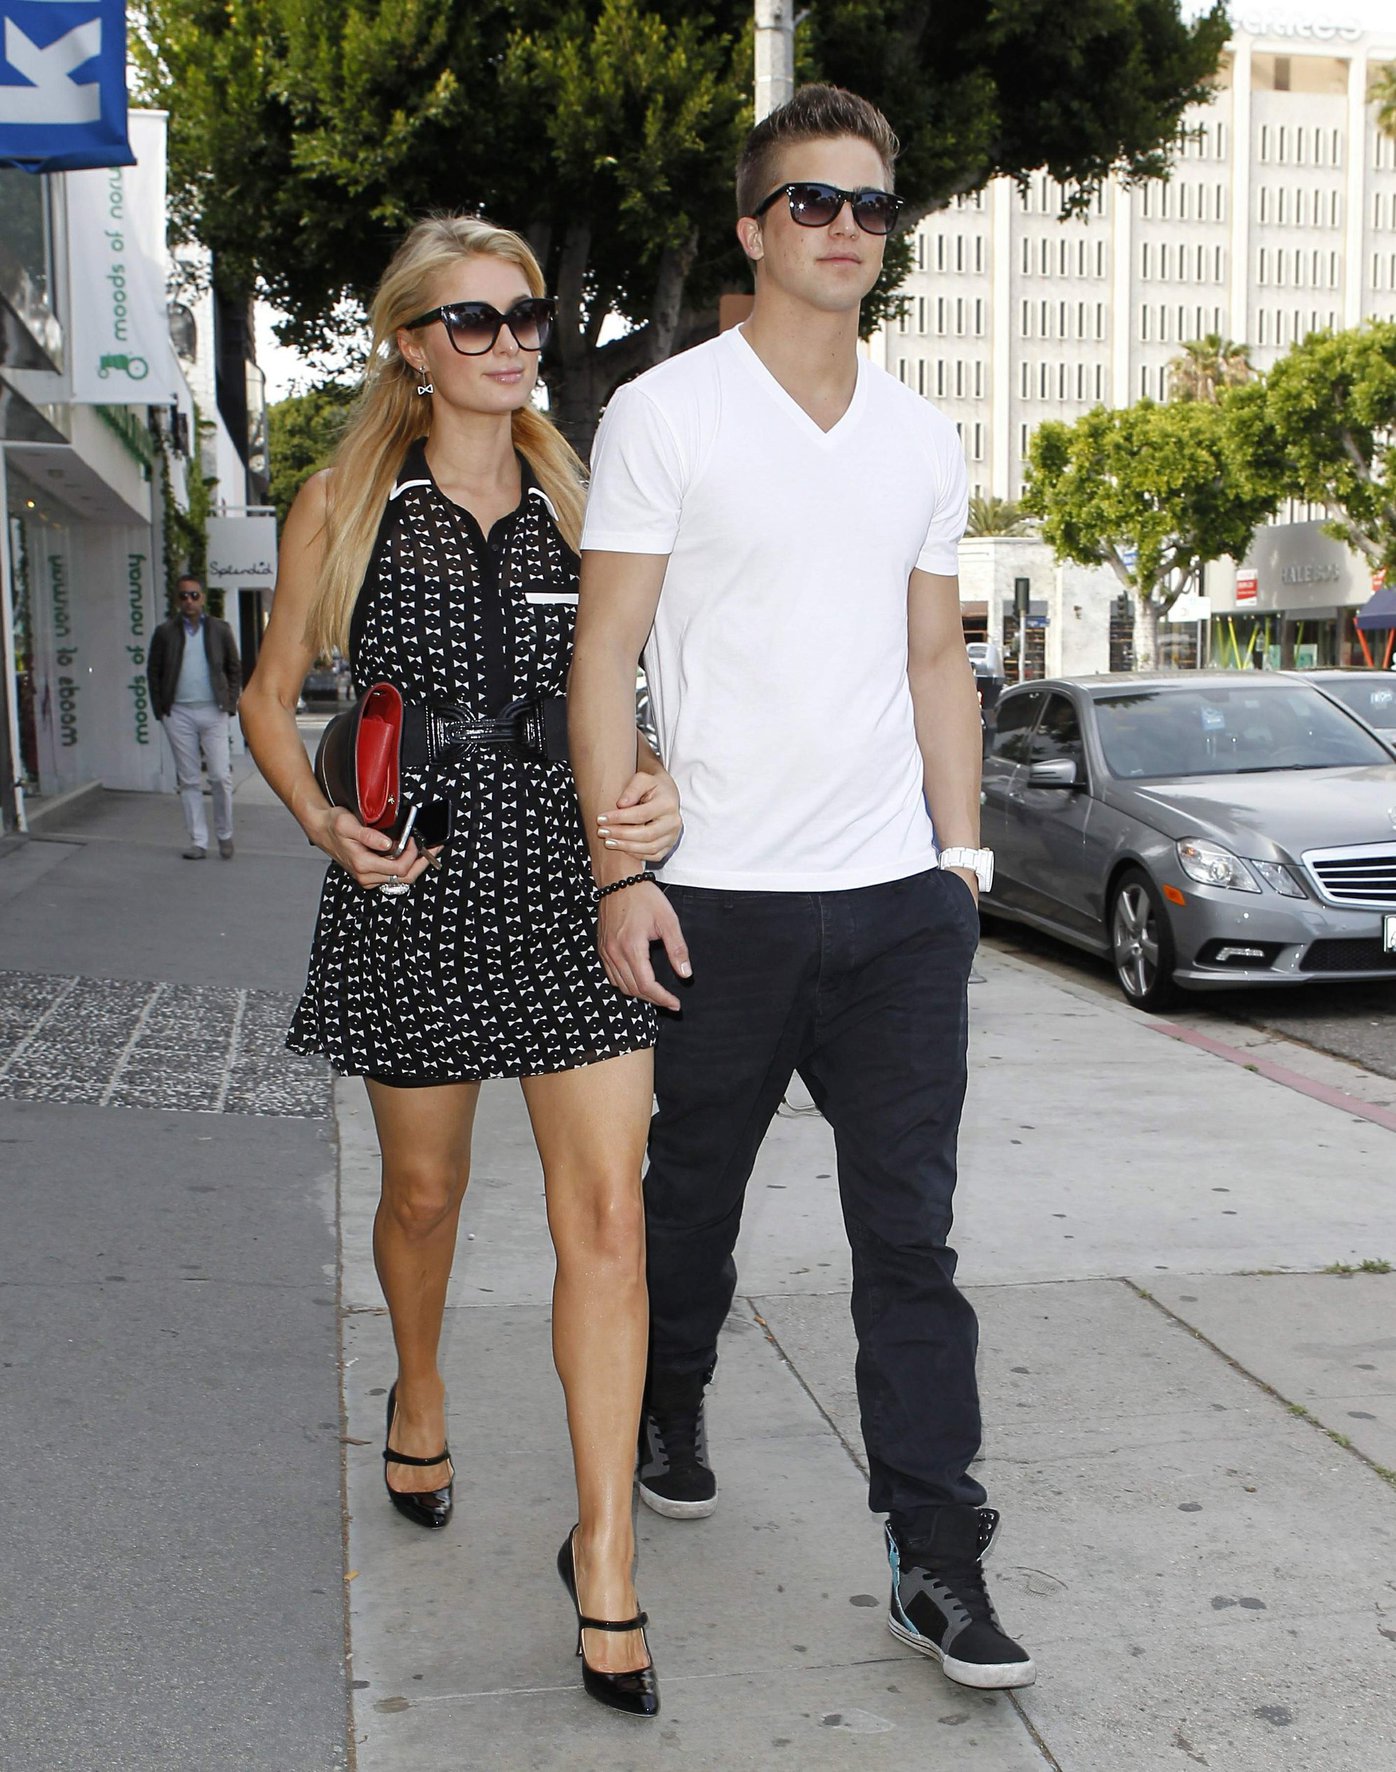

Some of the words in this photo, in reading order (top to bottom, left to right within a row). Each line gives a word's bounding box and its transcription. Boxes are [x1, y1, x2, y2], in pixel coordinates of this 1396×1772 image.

[0, 0, 101, 125] K
[108, 167, 125, 220] norw
[105, 230, 125, 253] of
[107, 264, 128, 342] moods
[127, 553, 147, 635] norway
[210, 561, 273, 578] Splendid
[126, 644, 146, 666] of
[127, 675, 149, 744] moods
